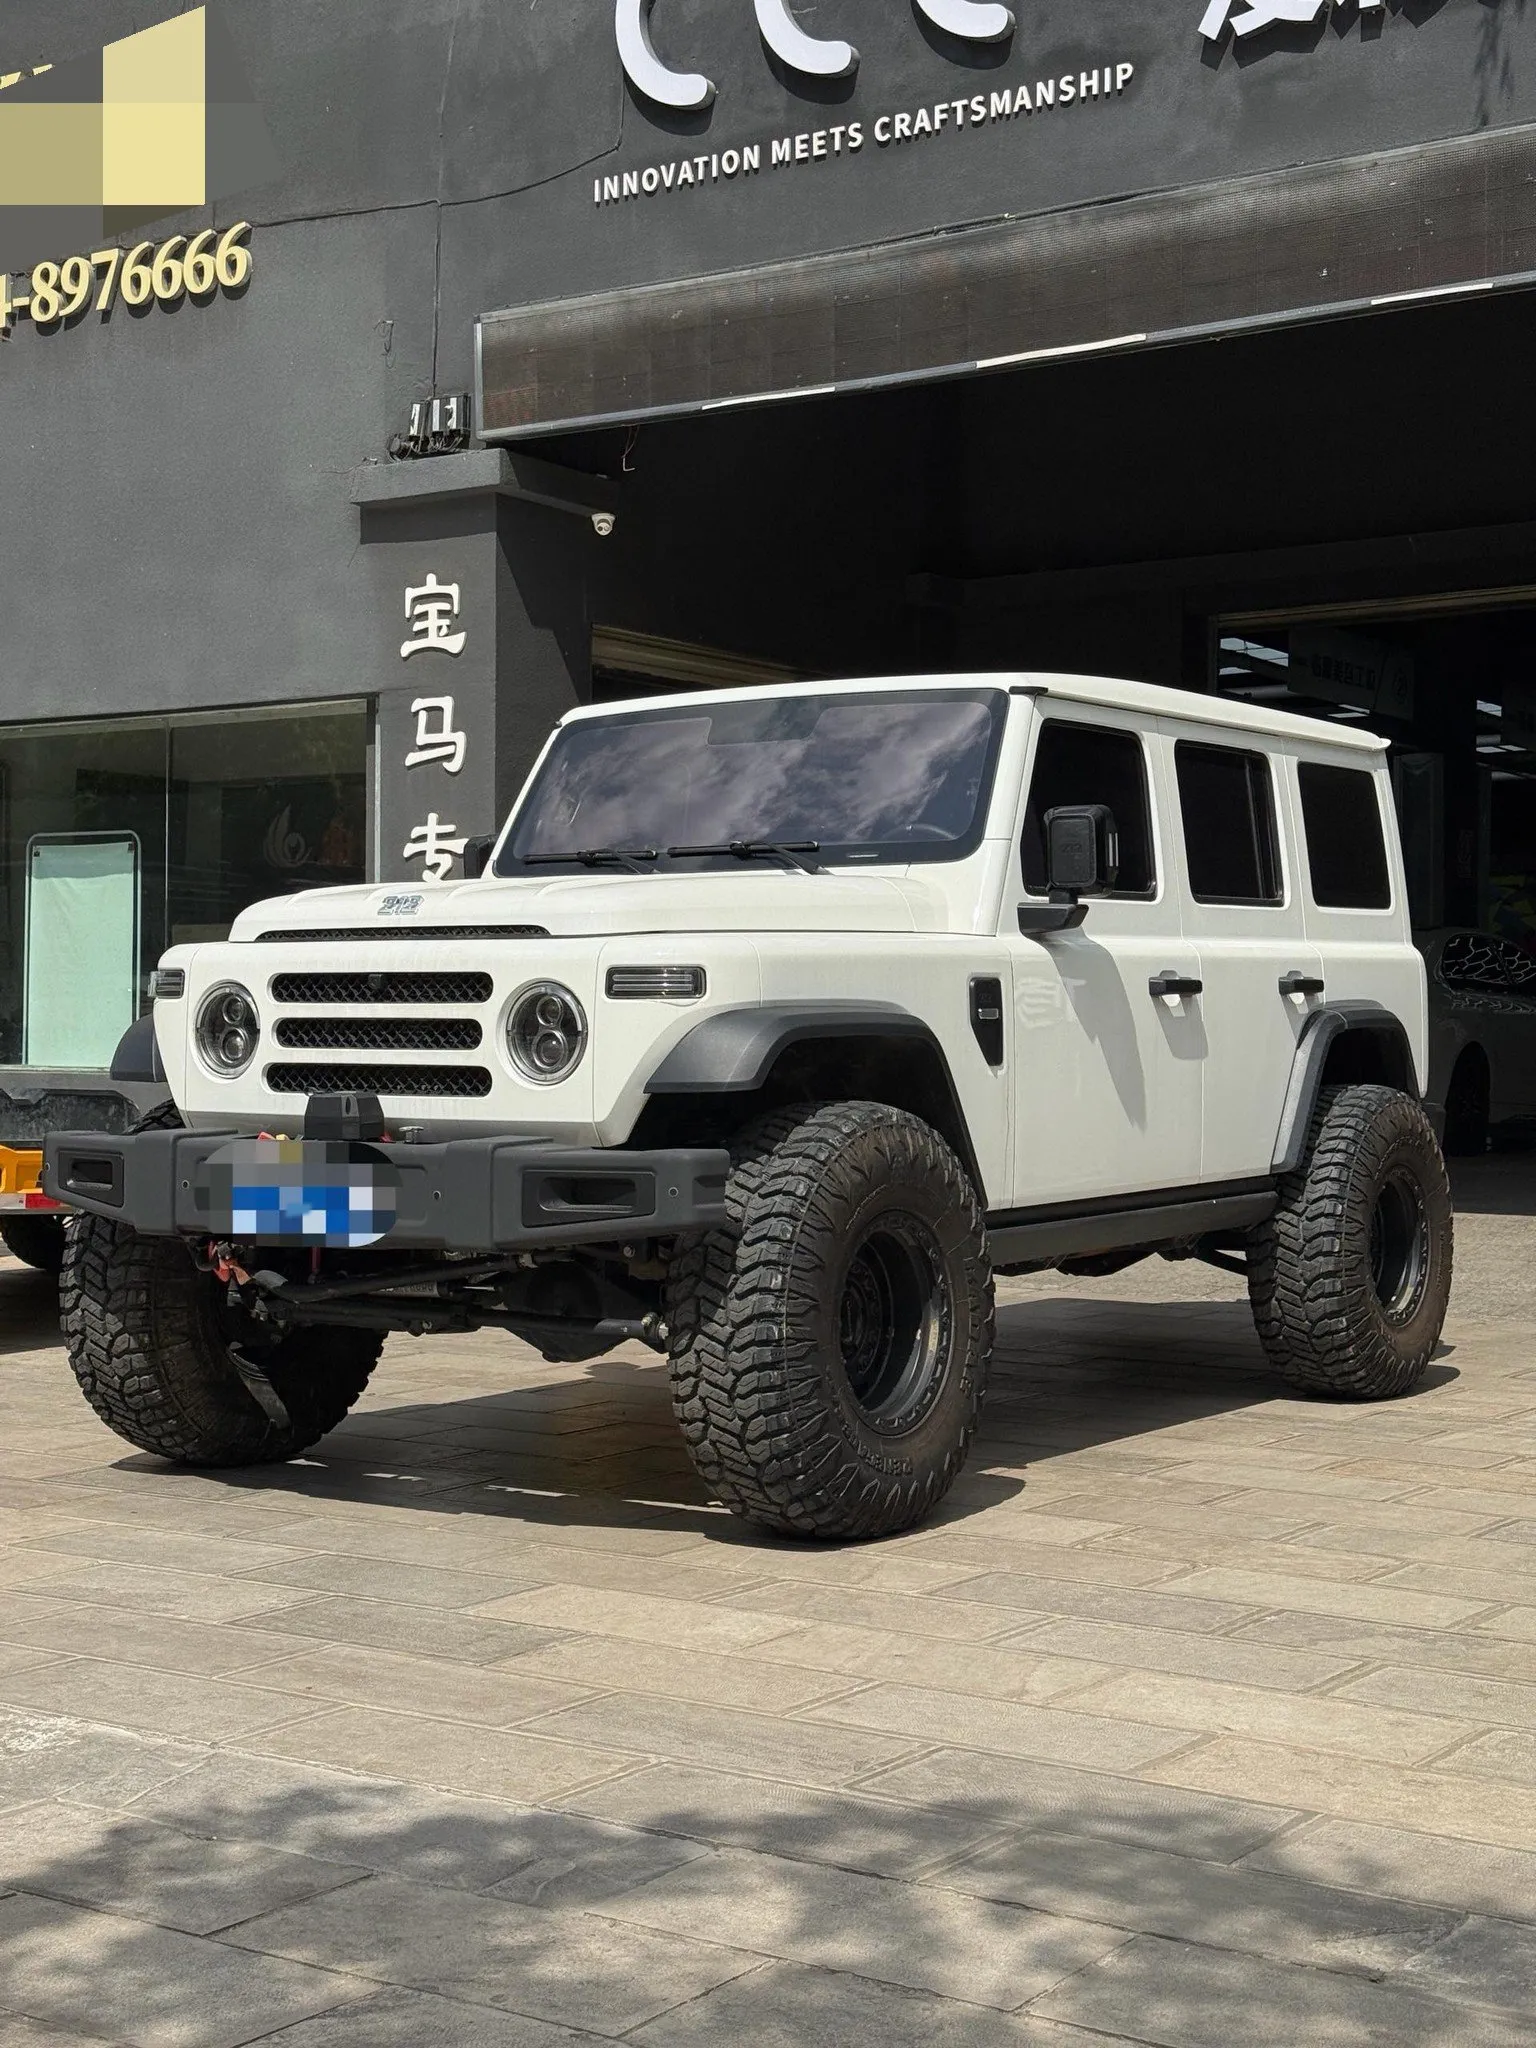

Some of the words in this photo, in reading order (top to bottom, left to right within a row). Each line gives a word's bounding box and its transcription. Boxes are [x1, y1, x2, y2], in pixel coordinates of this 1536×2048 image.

[594, 144, 761, 204] INNOVATION
[771, 122, 864, 165] MEETS
[873, 62, 1134, 143] CRAFTSMANSHIP
